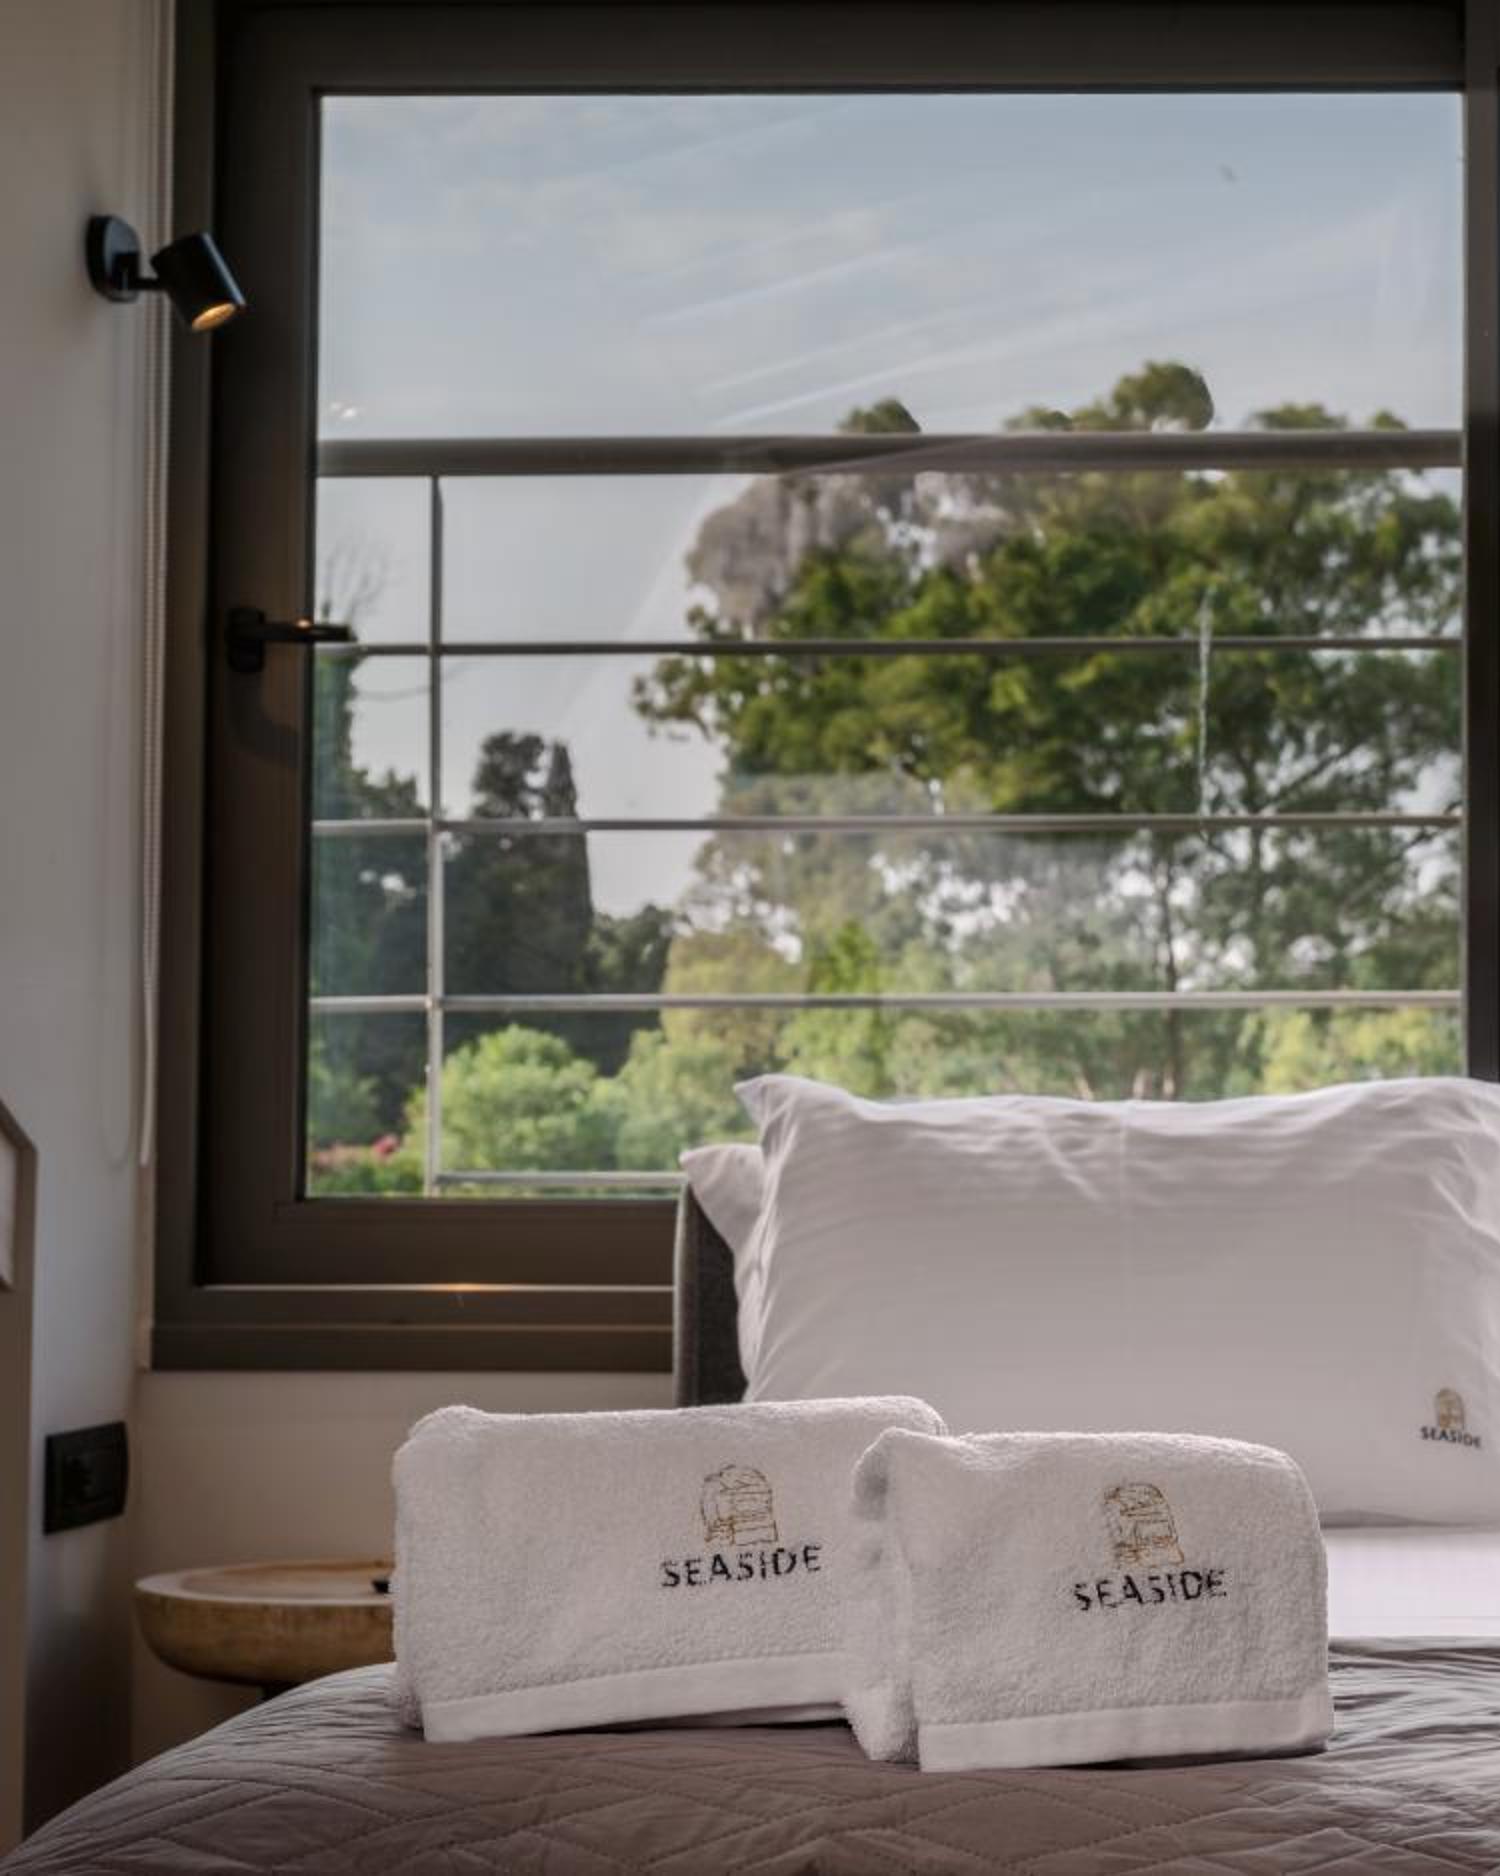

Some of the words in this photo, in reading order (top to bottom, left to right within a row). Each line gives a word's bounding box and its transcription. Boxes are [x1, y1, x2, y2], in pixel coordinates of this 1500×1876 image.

[1420, 1425, 1482, 1449] SEASIDE
[661, 1545, 823, 1588] SEASIDE
[1073, 1569, 1228, 1611] SEASIDE
